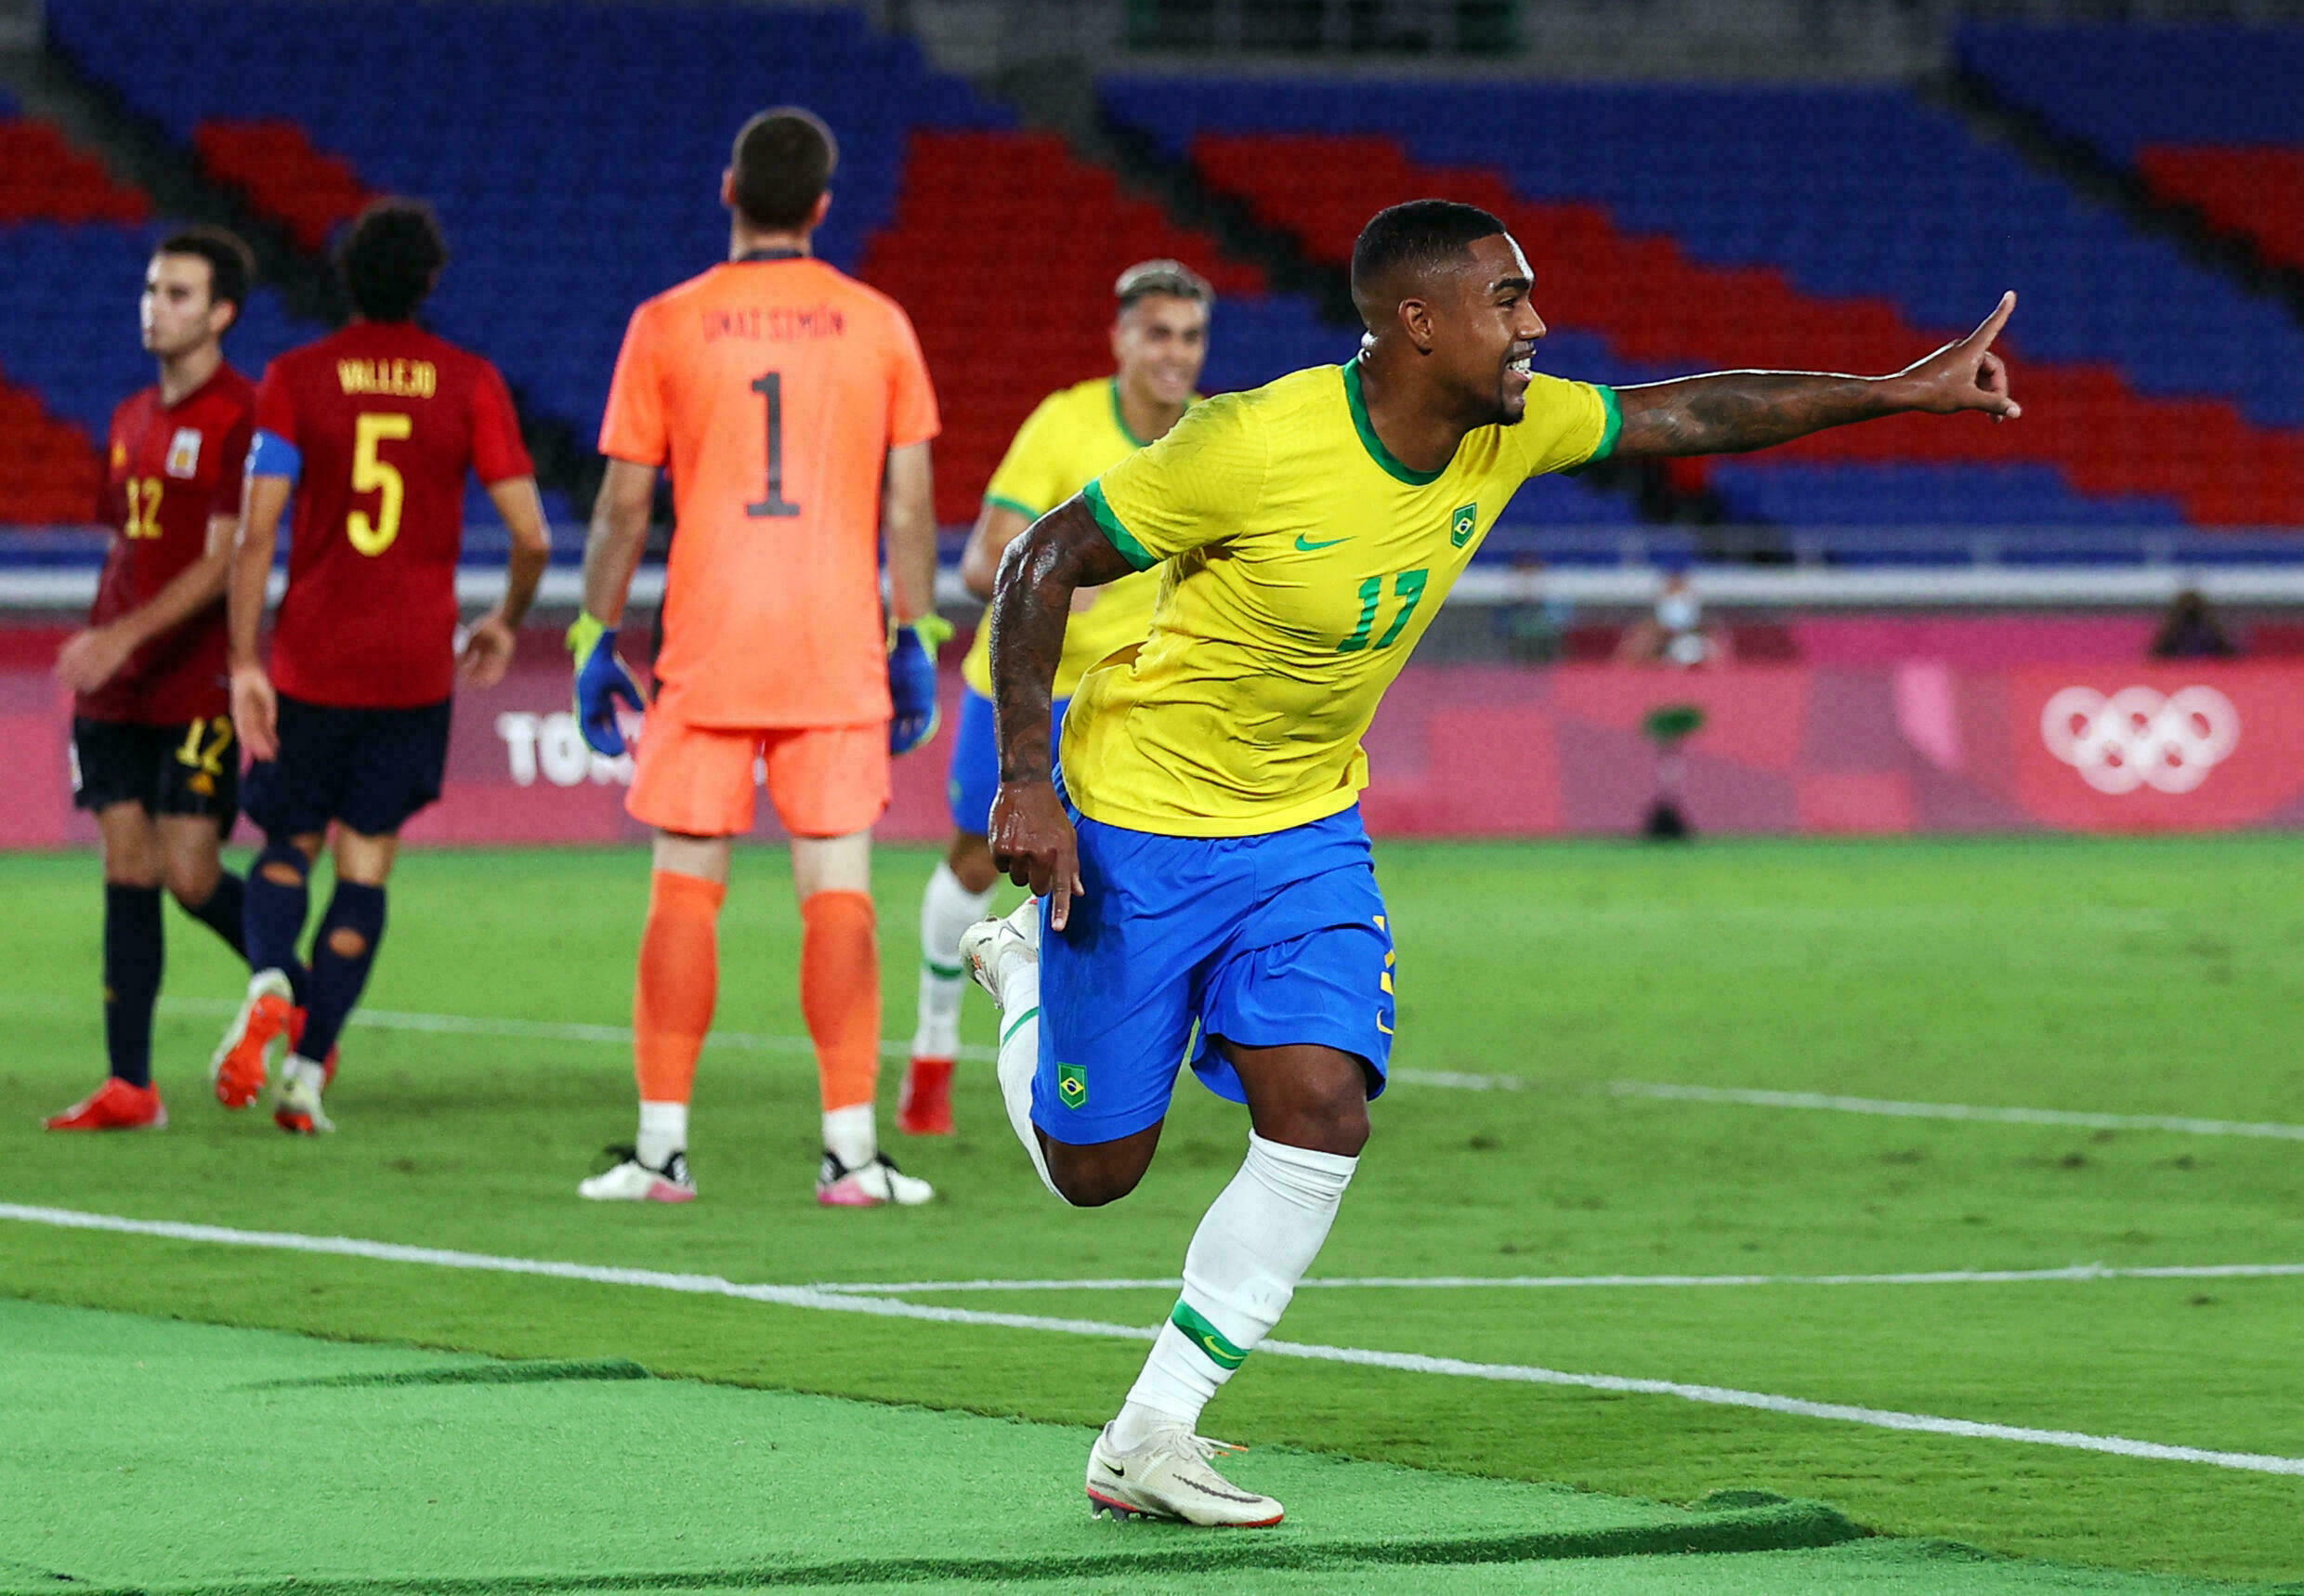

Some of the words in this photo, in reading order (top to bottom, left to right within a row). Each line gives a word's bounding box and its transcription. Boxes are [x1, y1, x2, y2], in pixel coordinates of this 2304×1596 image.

[337, 356, 437, 399] VALLEJO
[746, 371, 801, 517] 1
[124, 476, 164, 539] 12
[347, 412, 412, 557] 5
[1335, 568, 1429, 653] 17
[176, 715, 233, 776] 12
